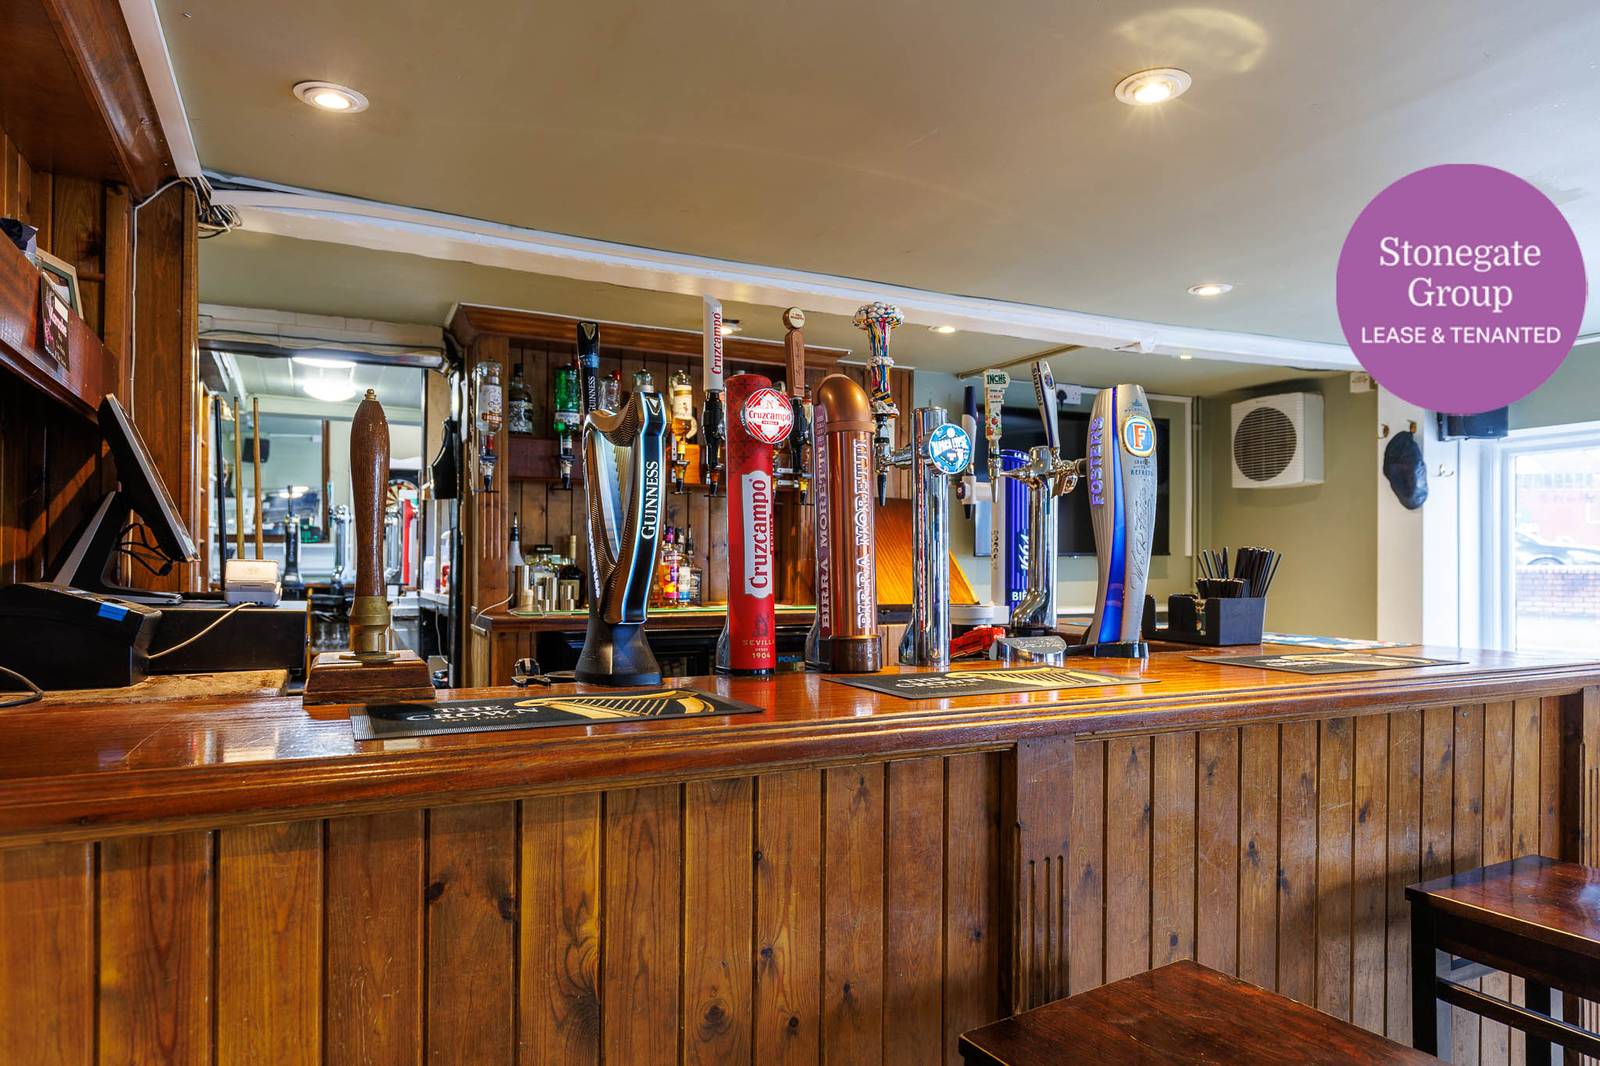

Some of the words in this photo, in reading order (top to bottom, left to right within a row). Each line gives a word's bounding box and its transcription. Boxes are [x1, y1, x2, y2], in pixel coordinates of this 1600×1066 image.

[711, 312, 722, 375] Cruzcampo
[749, 410, 790, 422] Cruzcampo
[641, 461, 659, 539] GUINNESS
[853, 438, 870, 546] MORETTI
[749, 479, 769, 589] Cruzcampo
[820, 558, 830, 628] BIRRA
[856, 555, 871, 629] BIRRA
[406, 707, 539, 721] CROWN
